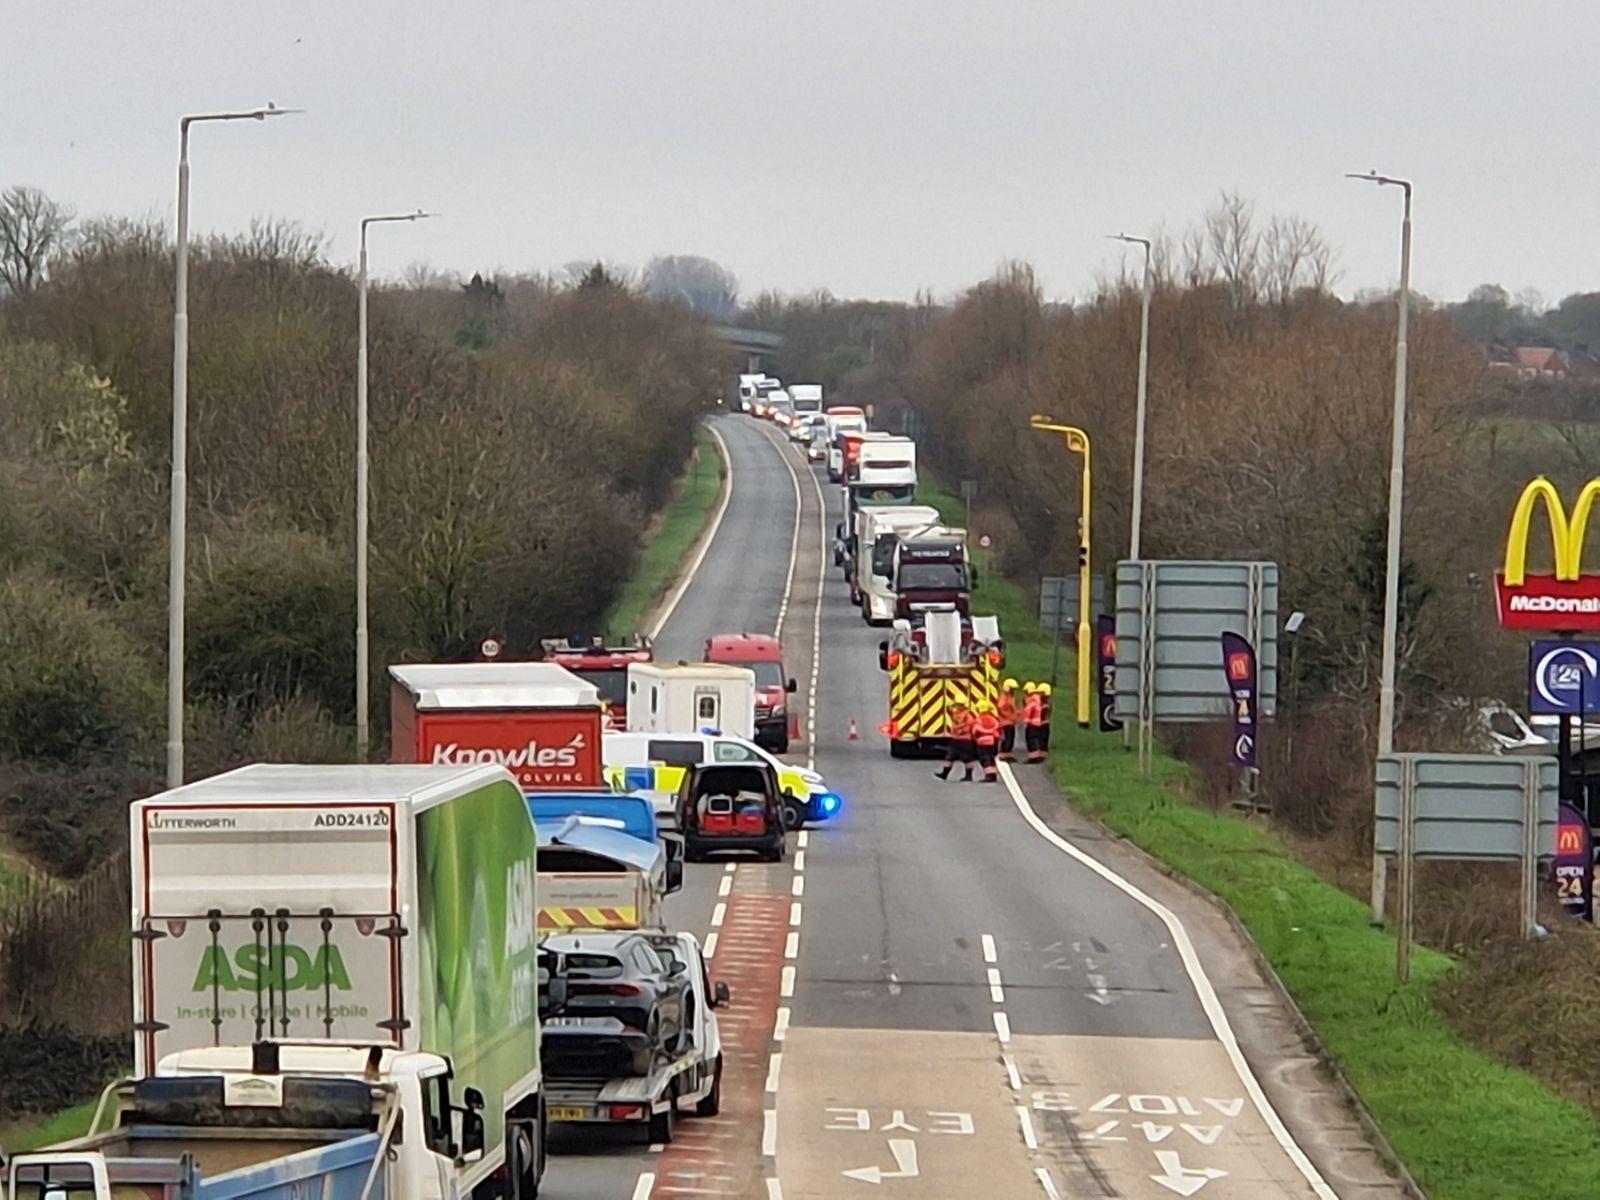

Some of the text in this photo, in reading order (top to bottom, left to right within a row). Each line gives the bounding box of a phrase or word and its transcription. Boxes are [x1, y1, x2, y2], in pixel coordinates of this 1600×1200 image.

[1510, 595, 1600, 612] McDonal
[432, 740, 577, 767] Knowles
[314, 813, 389, 827] ADD24120
[1556, 877, 1583, 897] 24
[192, 943, 353, 992] ASDA
[316, 1004, 369, 1018] Mobile
[824, 1108, 975, 1135] EYE
[1078, 1119, 1225, 1145] A47
